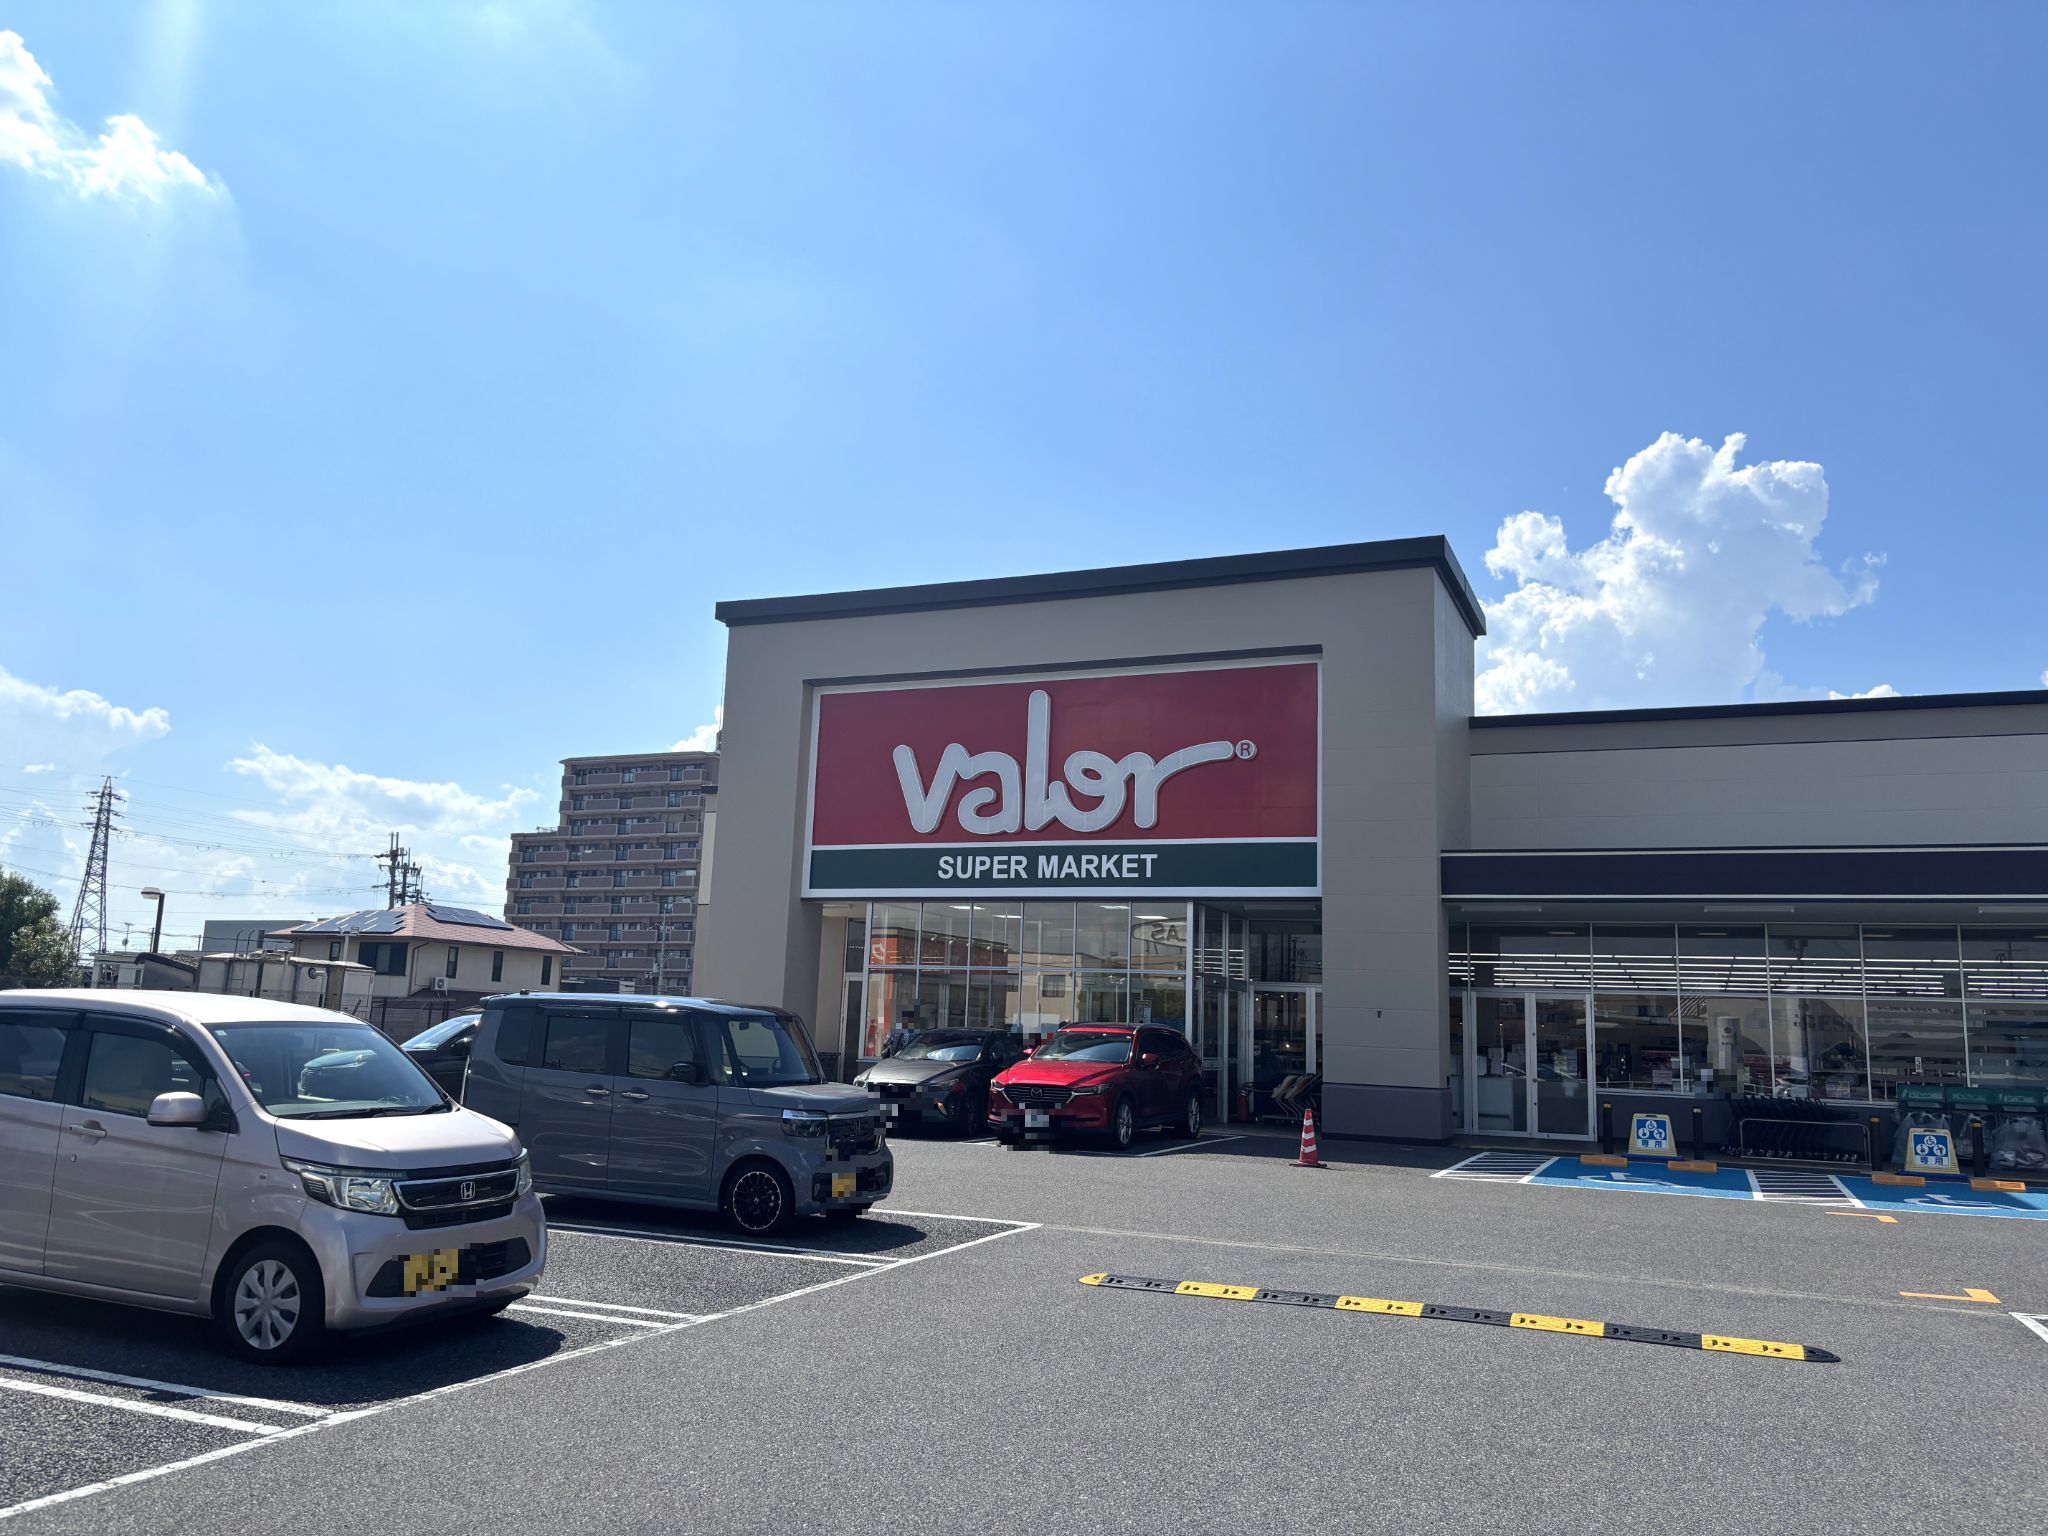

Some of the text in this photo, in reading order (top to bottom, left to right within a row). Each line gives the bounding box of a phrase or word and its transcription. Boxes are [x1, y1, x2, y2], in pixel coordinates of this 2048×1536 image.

[893, 689, 1233, 834] valor
[937, 853, 1158, 880] SUPER MARKET
[1641, 1139, 1663, 1148] 専用
[1919, 1156, 1944, 1165] 専用
